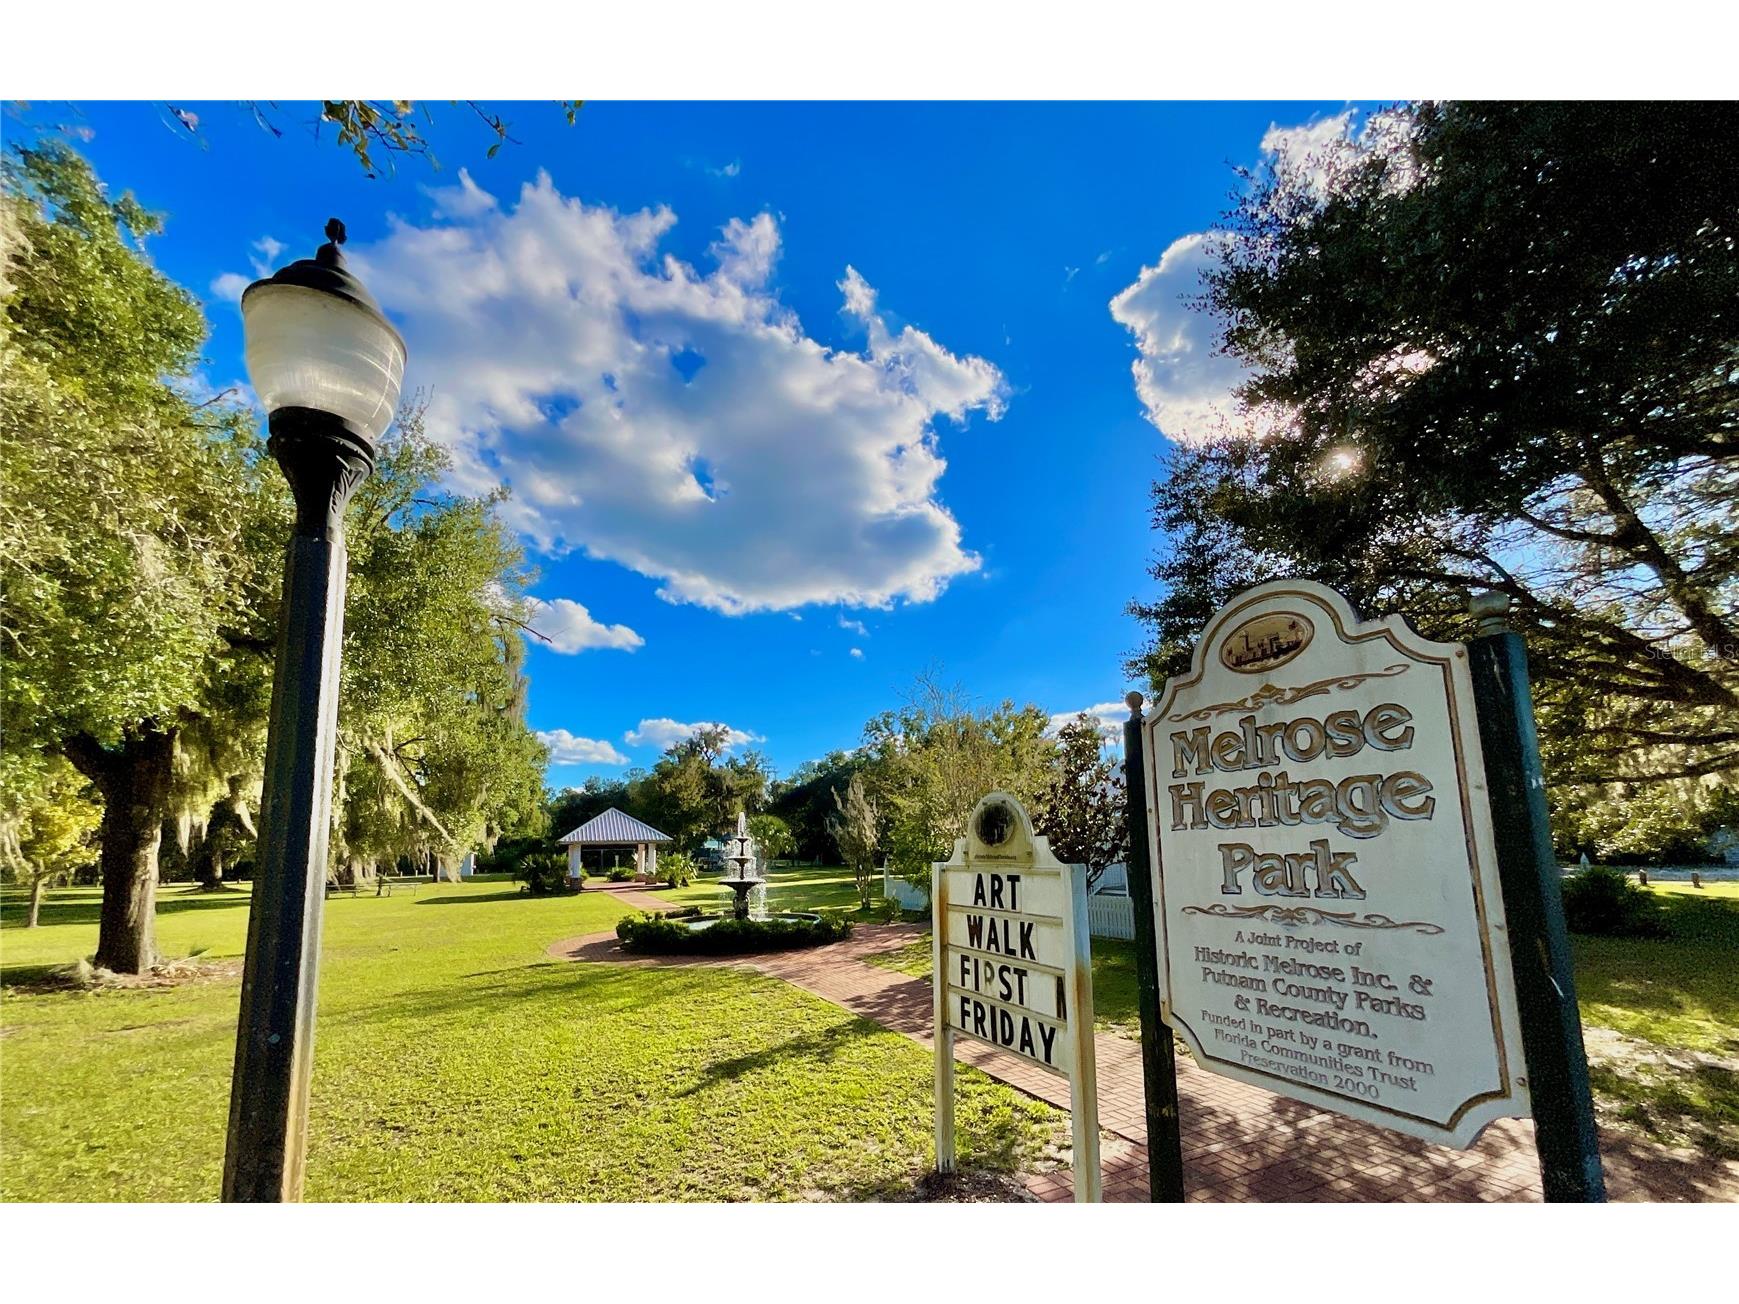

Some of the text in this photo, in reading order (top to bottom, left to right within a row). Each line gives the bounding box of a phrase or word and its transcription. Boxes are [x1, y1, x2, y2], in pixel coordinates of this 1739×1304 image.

[1169, 702, 1415, 778] Melrose
[1168, 770, 1436, 839] Heritage
[973, 873, 1021, 910] ART
[1217, 838, 1367, 900] Park
[966, 914, 1036, 961] WALK
[1234, 930, 1363, 956] A Joint Project of
[960, 954, 1028, 1006] FIRST
[1194, 946, 1433, 997] Historic Melrose Inc. &
[1201, 966, 1426, 1021] Putnam County Parks
[960, 995, 1056, 1065] FRIDAY
[1201, 1009, 1435, 1076] Funded in part by a grant from
[1234, 994, 1378, 1039] & Recreation.
[1214, 1028, 1418, 1093] Florida Communities Trust
[1240, 1049, 1380, 1099] Preservation 2000
